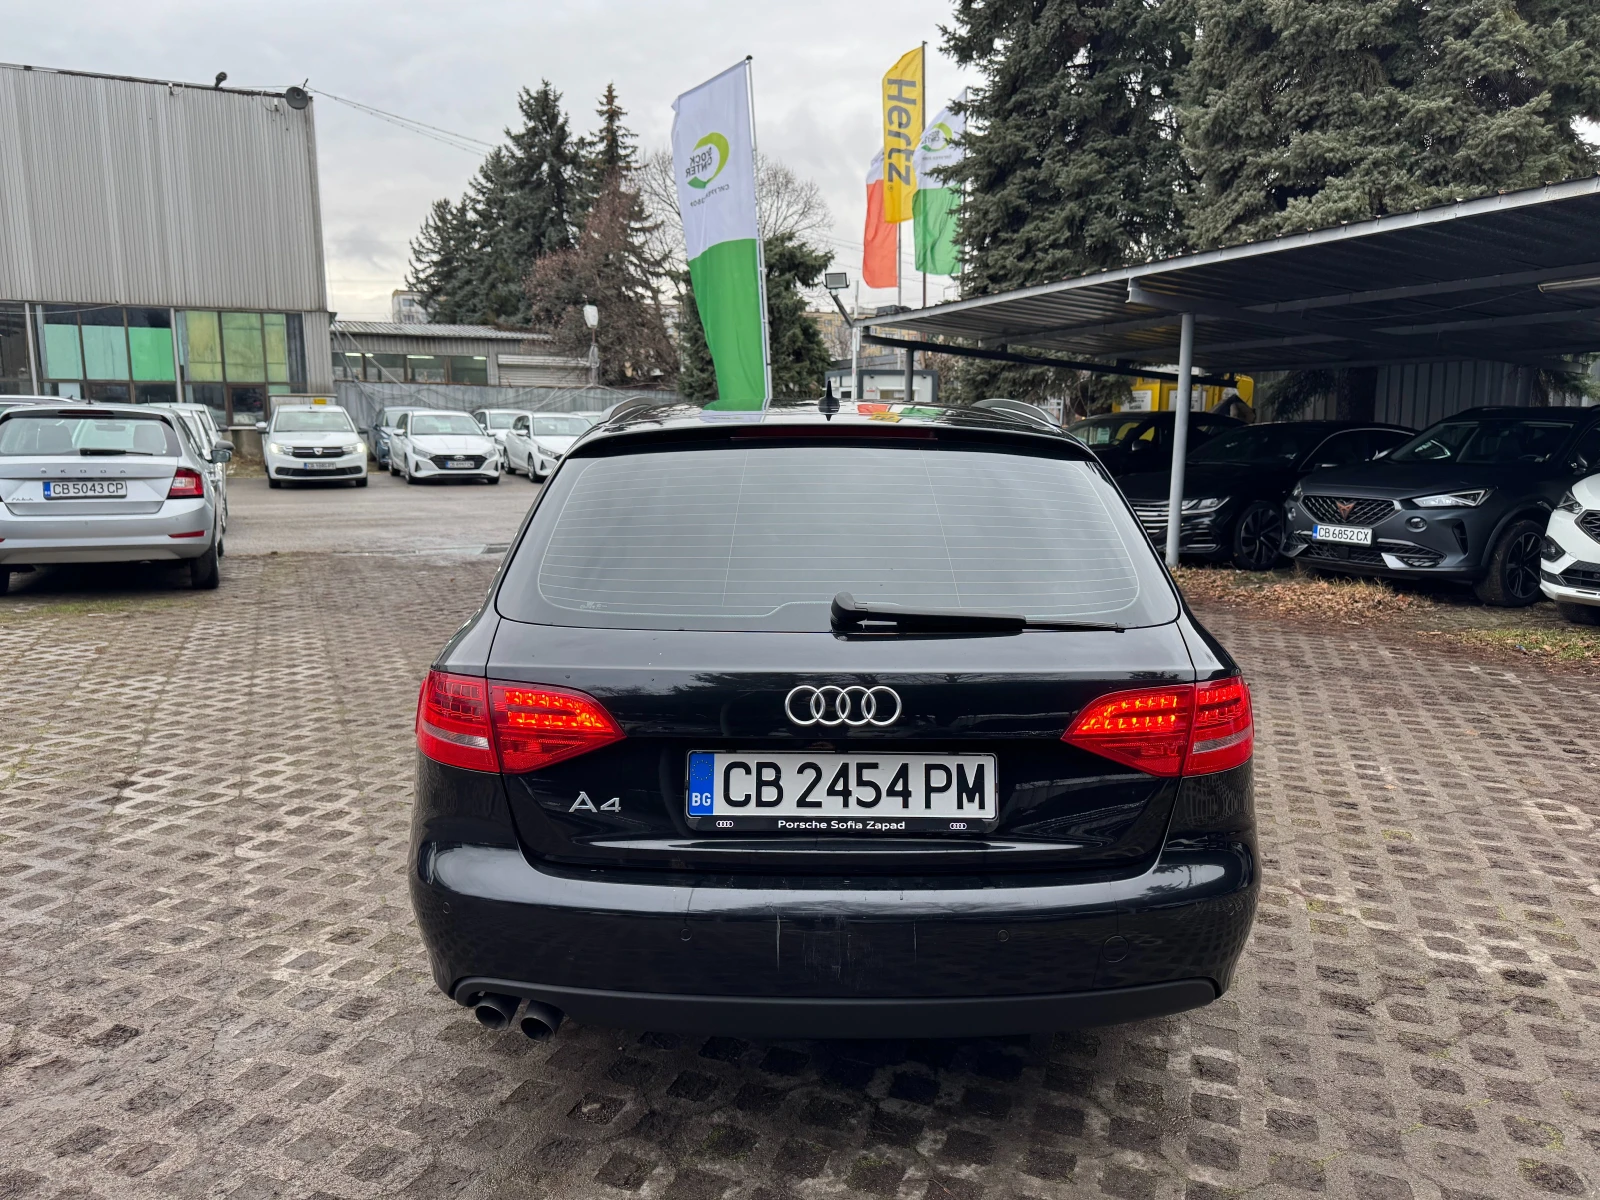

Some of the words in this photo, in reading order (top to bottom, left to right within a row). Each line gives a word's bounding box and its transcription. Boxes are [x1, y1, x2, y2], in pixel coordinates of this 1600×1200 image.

[887, 78, 917, 186] Hertz
[52, 483, 70, 496] CB
[72, 482, 105, 495] 5043
[106, 482, 124, 495] CP
[1318, 527, 1331, 538] CB
[1331, 528, 1355, 541] 6852
[1356, 530, 1369, 542] CX
[723, 761, 784, 808] CB
[796, 761, 912, 809] 2454
[924, 763, 986, 810] PM
[568, 790, 622, 813] A4
[691, 792, 712, 807] BG
[778, 819, 828, 829] Porsche
[830, 819, 863, 829] Sofia
[866, 820, 906, 831] Zapad
